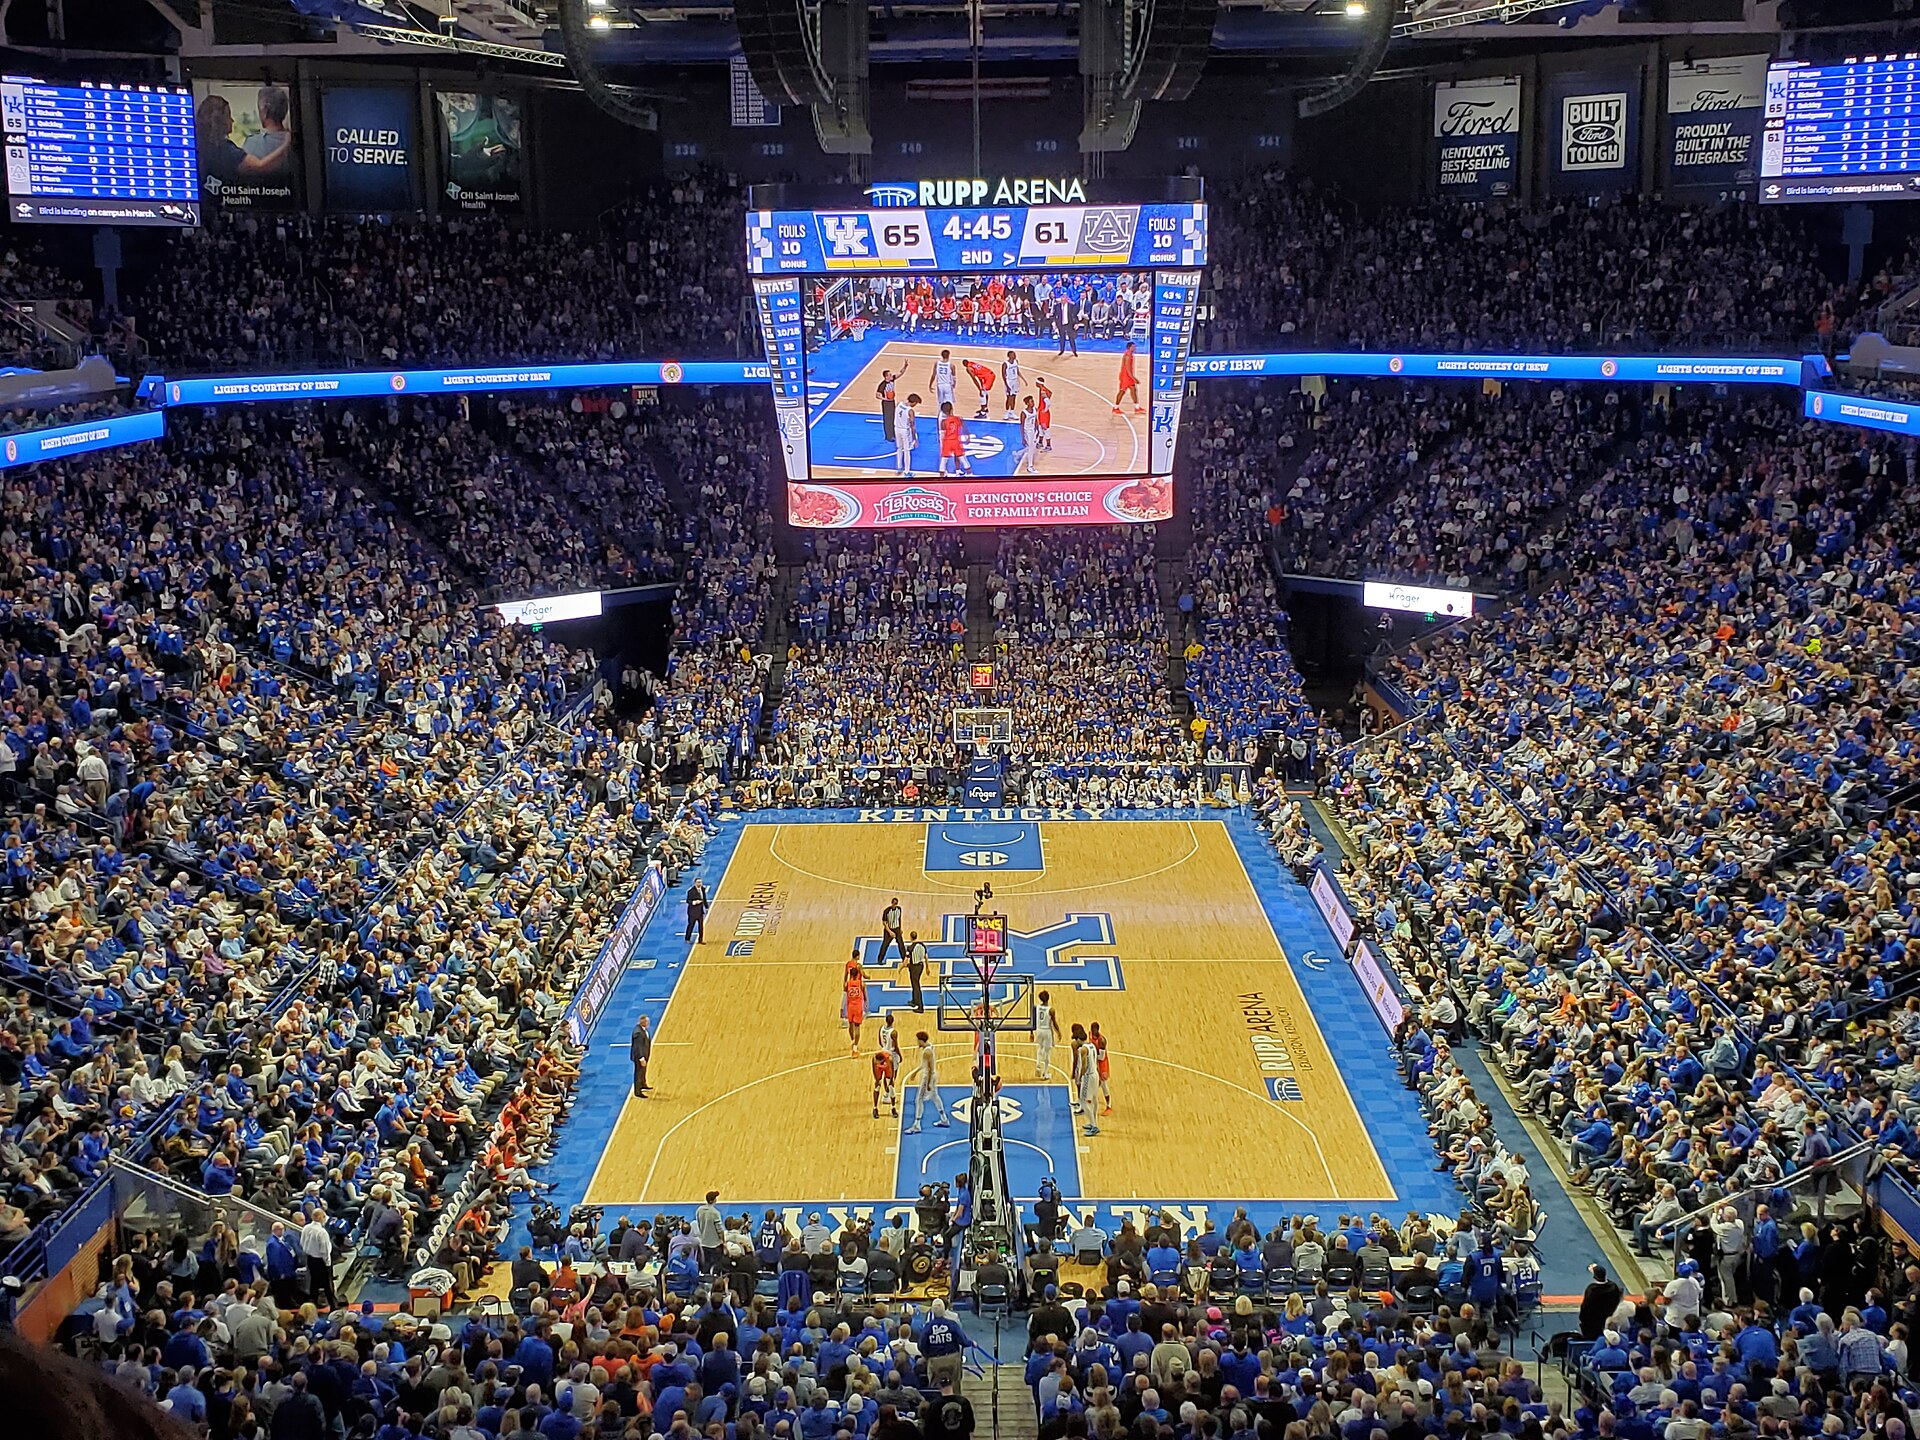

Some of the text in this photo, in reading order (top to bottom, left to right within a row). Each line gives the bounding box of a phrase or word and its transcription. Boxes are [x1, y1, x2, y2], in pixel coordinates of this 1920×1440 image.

[1691, 89, 1742, 112] Ford
[1568, 101, 1620, 123] BUILT
[1769, 104, 1782, 112] 65
[8, 119, 22, 128] 65
[1441, 100, 1514, 134] Ford
[1766, 120, 1784, 128] 4:45
[336, 128, 399, 146] CALLED
[1579, 127, 1607, 141] Ford
[1676, 122, 1732, 138] PROUDLY
[6, 135, 26, 144] 4:45
[1675, 135, 1752, 152] BUILT IN THE
[1768, 134, 1780, 142] 61
[10, 149, 24, 158] 61
[329, 147, 408, 166] TO SERVE.
[1442, 145, 1504, 160] KENTUCKY'S
[1568, 145, 1618, 162] TOUGH
[1674, 150, 1748, 166] BLUEGRASS.
[1441, 157, 1510, 172] BEST-SELLING
[1440, 172, 1478, 184] BRAND.
[221, 186, 291, 198] CHI Saint Joseph
[919, 177, 1087, 206] RUPP ARENA
[1786, 186, 1800, 194] Bird
[1807, 186, 1832, 195] landing
[1843, 185, 1871, 194] campus
[1880, 182, 1904, 192] March.
[223, 196, 251, 205] Health
[460, 191, 520, 202] CHI Saint Joseph
[462, 200, 486, 210] Health
[40, 207, 54, 216] Bird
[60, 208, 87, 218] landing
[98, 210, 124, 218] campus
[126, 209, 132, 217] in
[132, 210, 156, 218] March.
[778, 224, 806, 238] FOULS
[942, 214, 1012, 240] 4:45
[1148, 218, 1176, 232] FOULS
[823, 216, 869, 255] UK
[884, 225, 920, 246] 65
[1035, 222, 1068, 244] 61
[782, 242, 801, 254] 10
[1153, 234, 1172, 248] 10
[780, 260, 808, 269] BONUS
[962, 251, 992, 264] 2ND
[1150, 254, 1176, 262] BONUS
[777, 298, 788, 306] 40
[1161, 306, 1182, 316] 2/10
[1160, 350, 1171, 358] 10
[1209, 360, 1228, 372] OF
[1229, 359, 1266, 371] IBEW
[1437, 361, 1550, 372] LIGHTS COURTESY OF IBEW
[1657, 364, 1784, 376] LIGHTS COURTESY OF IBEW
[443, 372, 552, 386] LIGHTS COURTESY OF IBEW
[214, 380, 339, 394] LIGHTS COURTESY OF IBEW
[884, 495, 944, 513] LaRosa's
[966, 492, 1092, 504] LEXINGTON'S CHOICE
[968, 504, 1089, 517] FOR FAMILY ITALIAN
[1389, 588, 1420, 608] Kroger
[522, 602, 553, 620] Kroger
[976, 666, 992, 674] 4:45
[973, 673, 990, 686] 30
[969, 786, 997, 802] Kroger
[857, 808, 1105, 822] KENTUCKY
[958, 851, 1009, 866] SEC
[744, 880, 779, 910] ARENA
[734, 910, 768, 936] RUPP
[976, 919, 1002, 930] 4:45
[975, 930, 998, 952] 30
[850, 988, 860, 997] 23
[1237, 992, 1296, 1071] RUPP ARENA
[762, 1234, 775, 1249] 07
[1483, 1264, 1492, 1276] 0
[1520, 1267, 1532, 1280] 23
[929, 1332, 952, 1344] CATS
